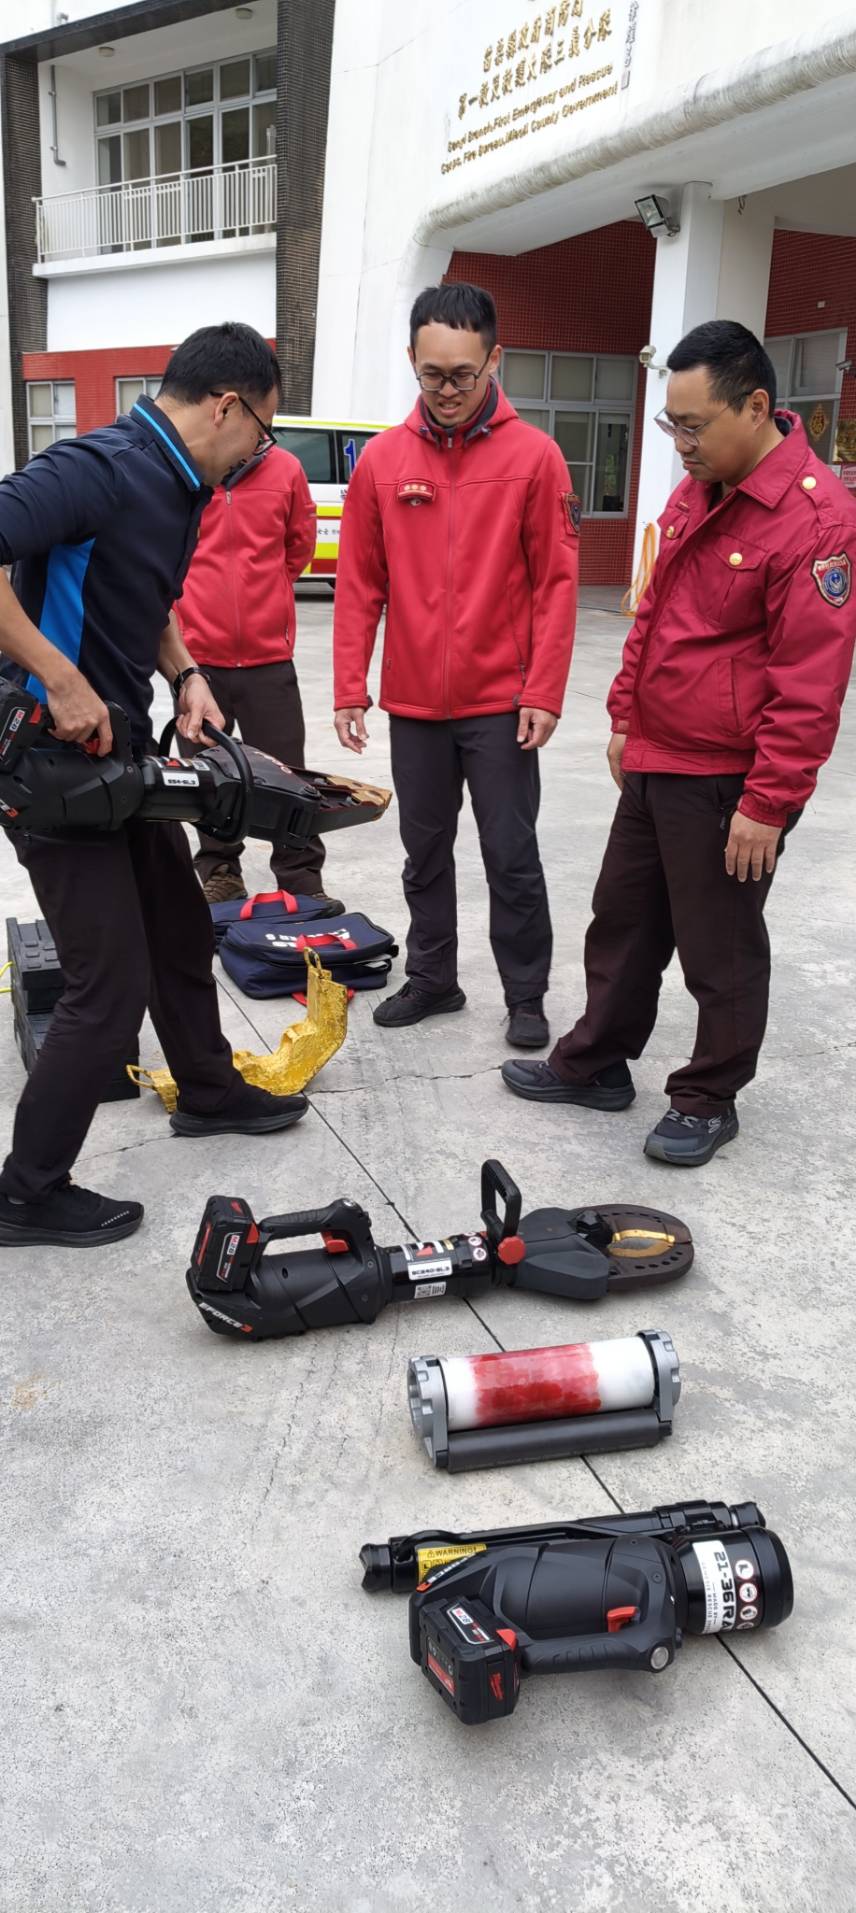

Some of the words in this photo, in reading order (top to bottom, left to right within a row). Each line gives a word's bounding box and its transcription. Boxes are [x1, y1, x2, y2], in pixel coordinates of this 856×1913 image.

[512, 90, 557, 121] Emergency
[559, 78, 576, 98] and
[578, 64, 613, 88] Rescue
[531, 111, 559, 132] County
[562, 80, 618, 117] Government
